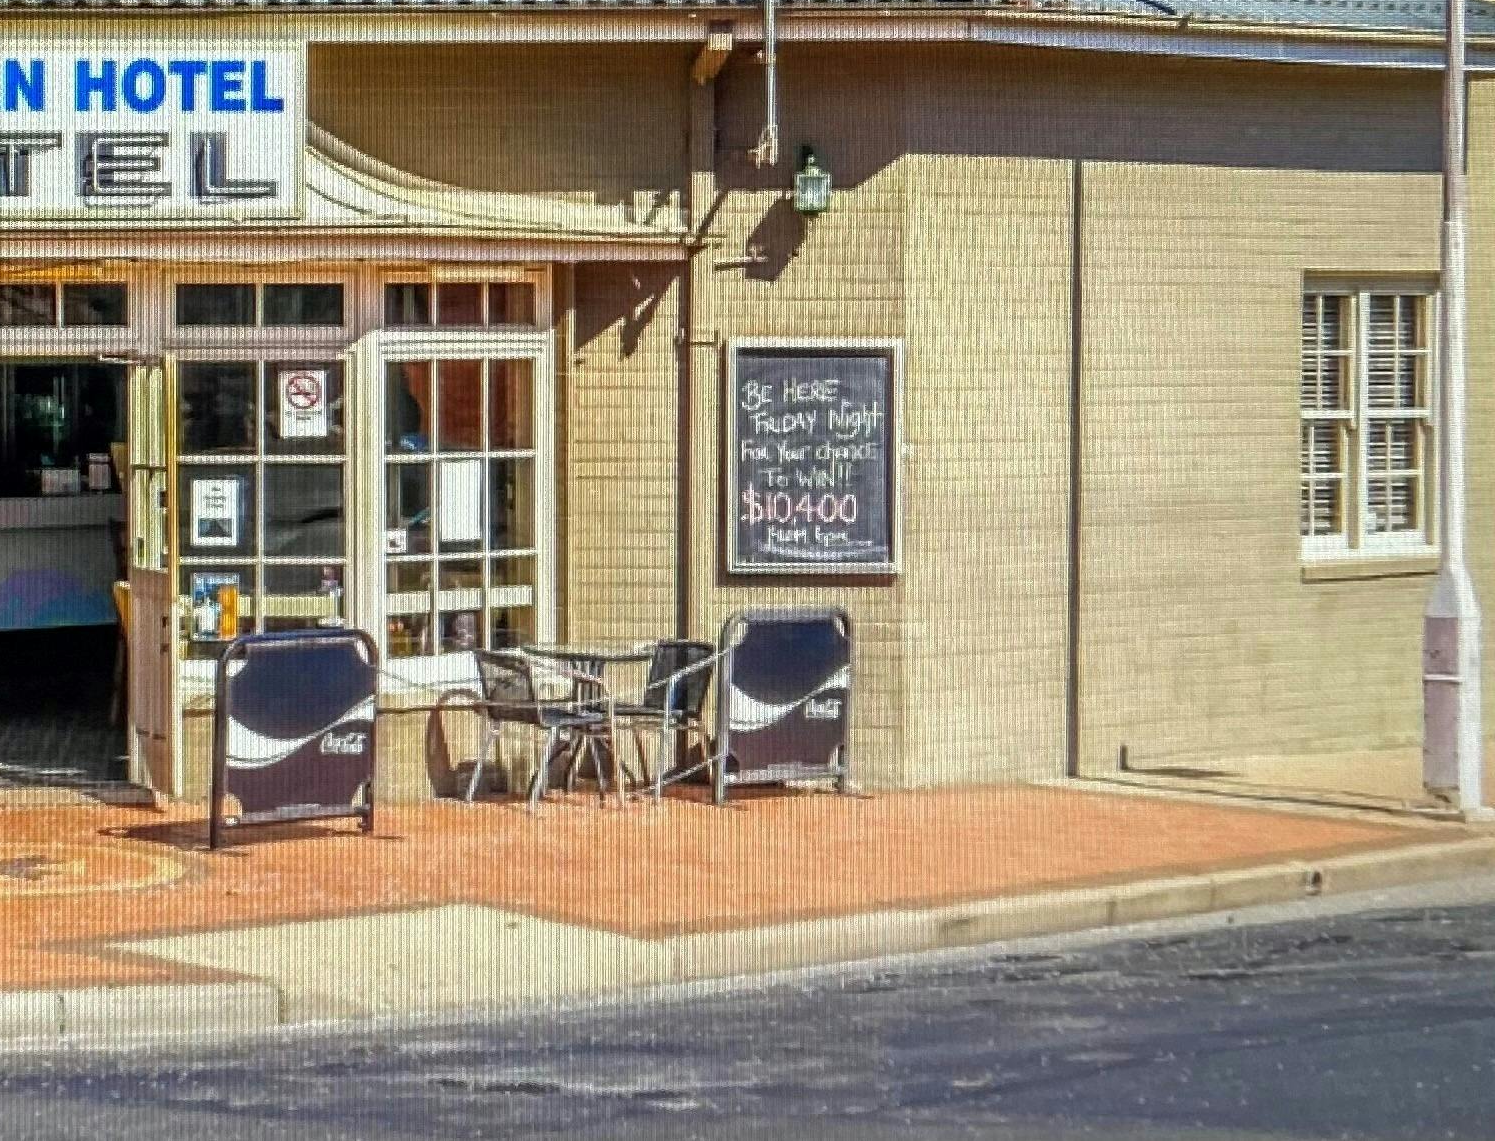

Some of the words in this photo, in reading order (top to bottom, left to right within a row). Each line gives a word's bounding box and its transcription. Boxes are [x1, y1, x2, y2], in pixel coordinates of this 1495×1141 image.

[74, 59, 285, 113] HOTEL
[741, 379, 773, 410] BE
[783, 377, 841, 403] HERE
